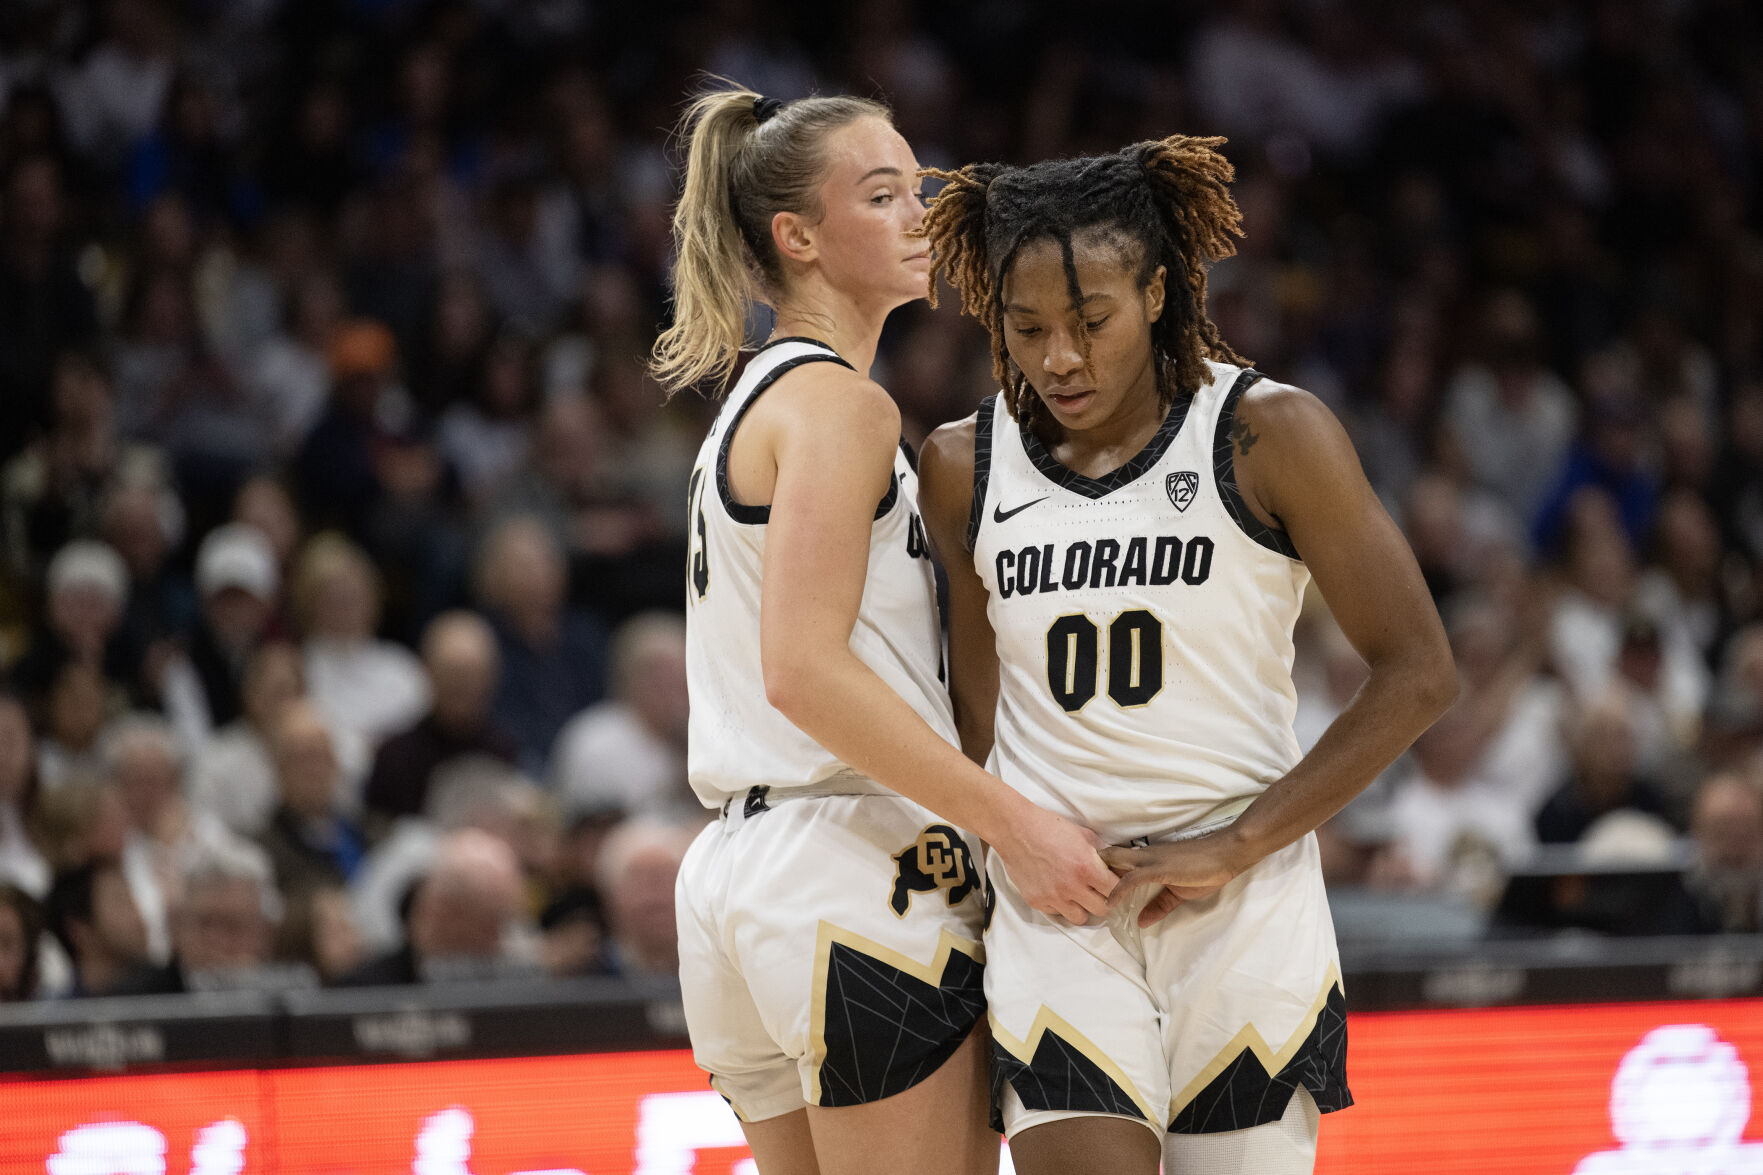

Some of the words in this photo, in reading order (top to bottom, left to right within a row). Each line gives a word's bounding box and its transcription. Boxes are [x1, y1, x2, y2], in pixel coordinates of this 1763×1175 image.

[1168, 472, 1197, 495] PAC
[1174, 487, 1190, 502] 12
[995, 536, 1215, 599] COLORADO
[1045, 608, 1165, 714] 00
[916, 832, 966, 889] CU
